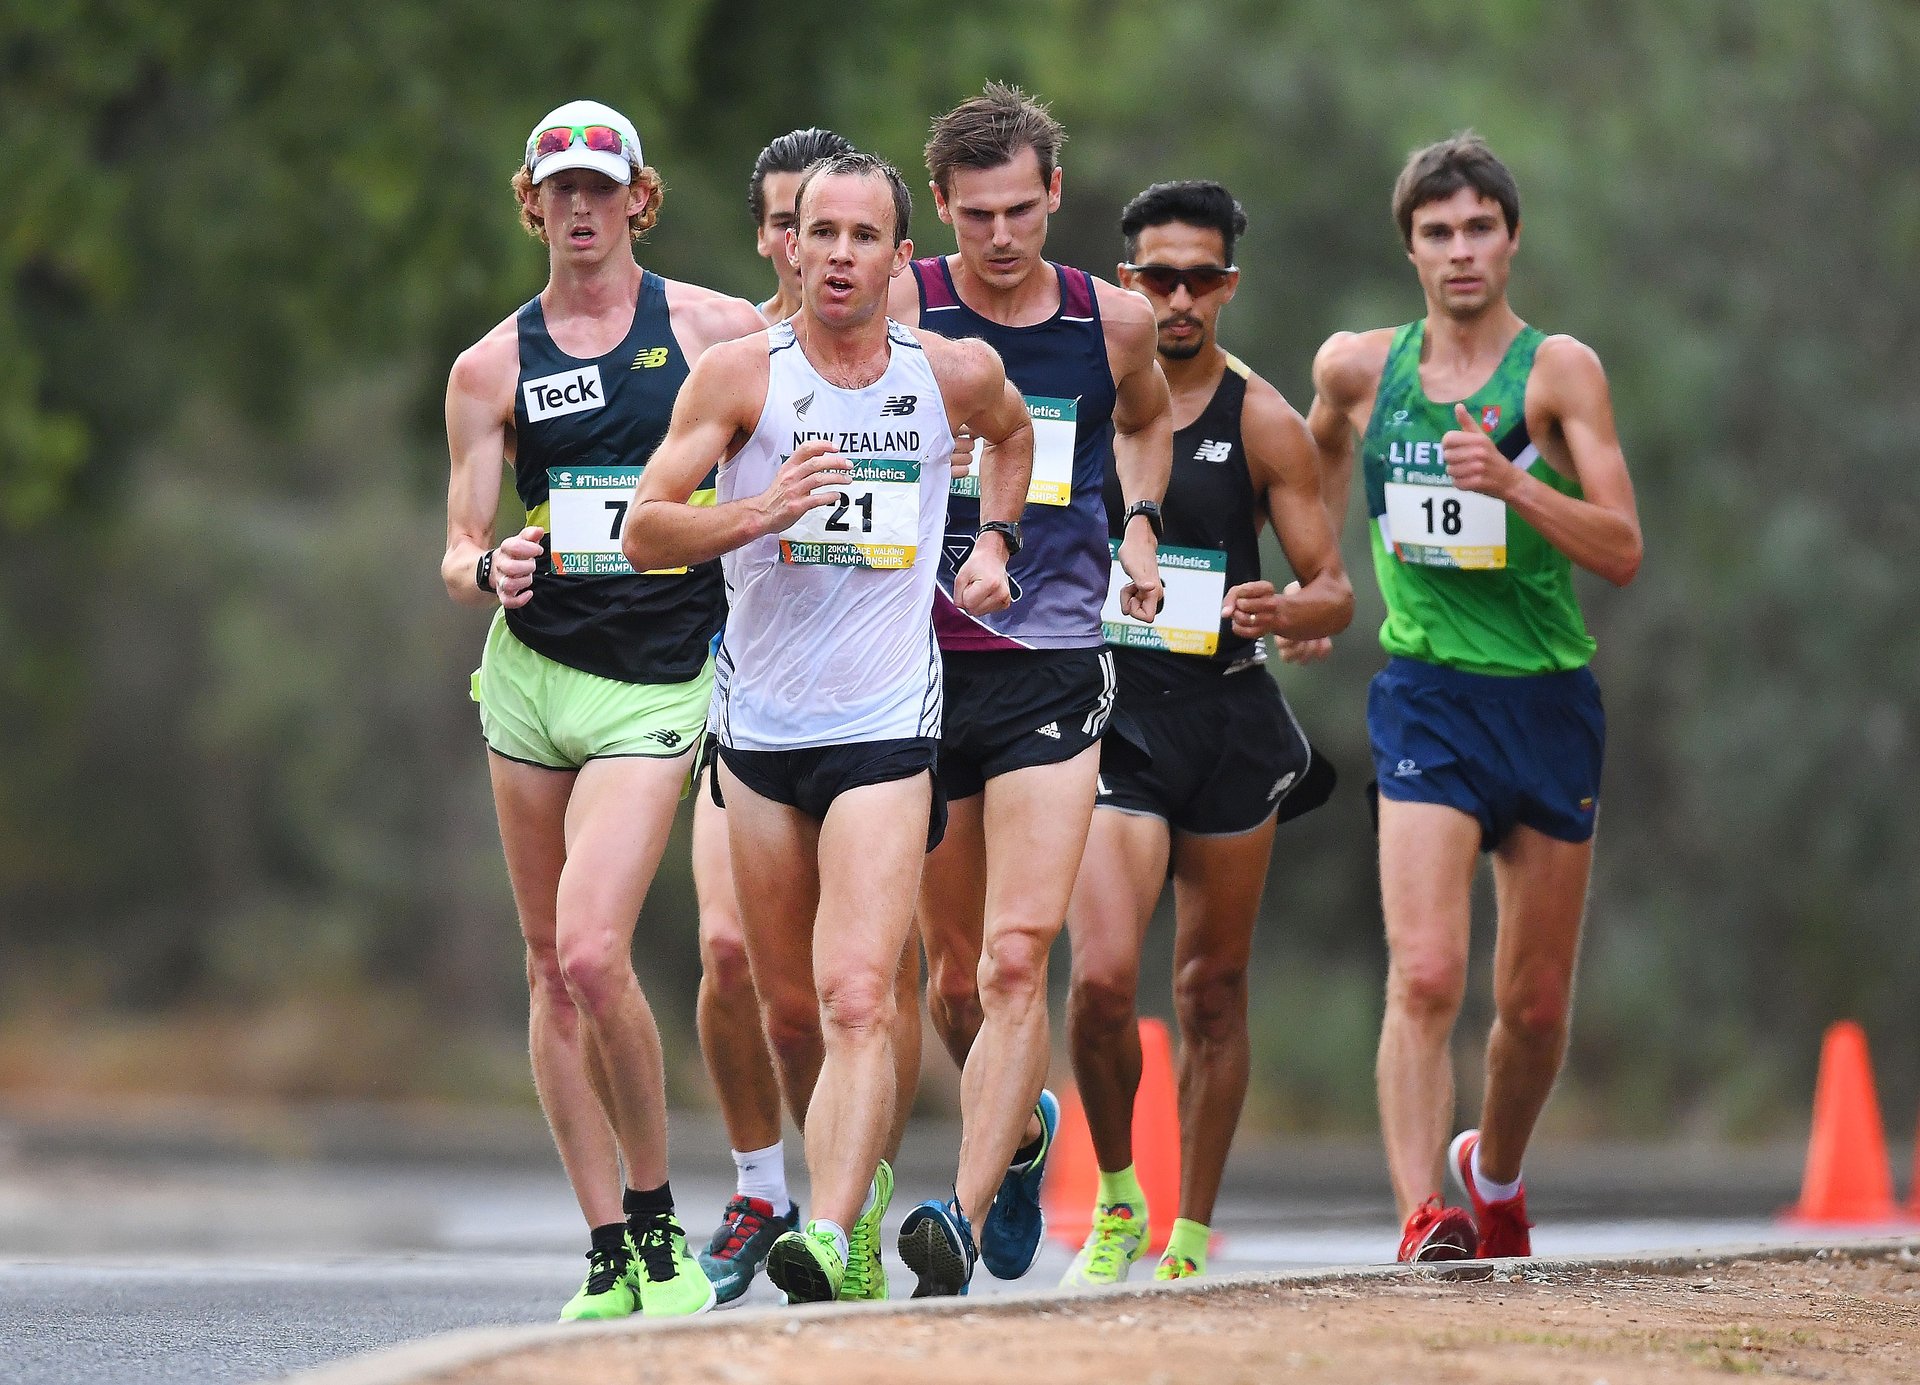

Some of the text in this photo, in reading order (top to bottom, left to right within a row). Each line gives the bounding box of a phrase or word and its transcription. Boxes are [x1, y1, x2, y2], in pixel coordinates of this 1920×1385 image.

[530, 375, 599, 411] Teck
[839, 431, 920, 453] ZEALAND
[1389, 441, 1445, 465] LIET
[825, 491, 873, 533] 21
[1421, 497, 1462, 535] 18
[605, 500, 628, 540] 7
[791, 544, 821, 557] 2018
[828, 545, 905, 556] 20KM RACE WALKING
[562, 554, 589, 567] 2018
[595, 554, 616, 564] 20KM
[790, 555, 821, 563] ADELAIDE
[827, 554, 903, 566] CHAMPIONSHIPS
[562, 565, 590, 573] ADELAIDE
